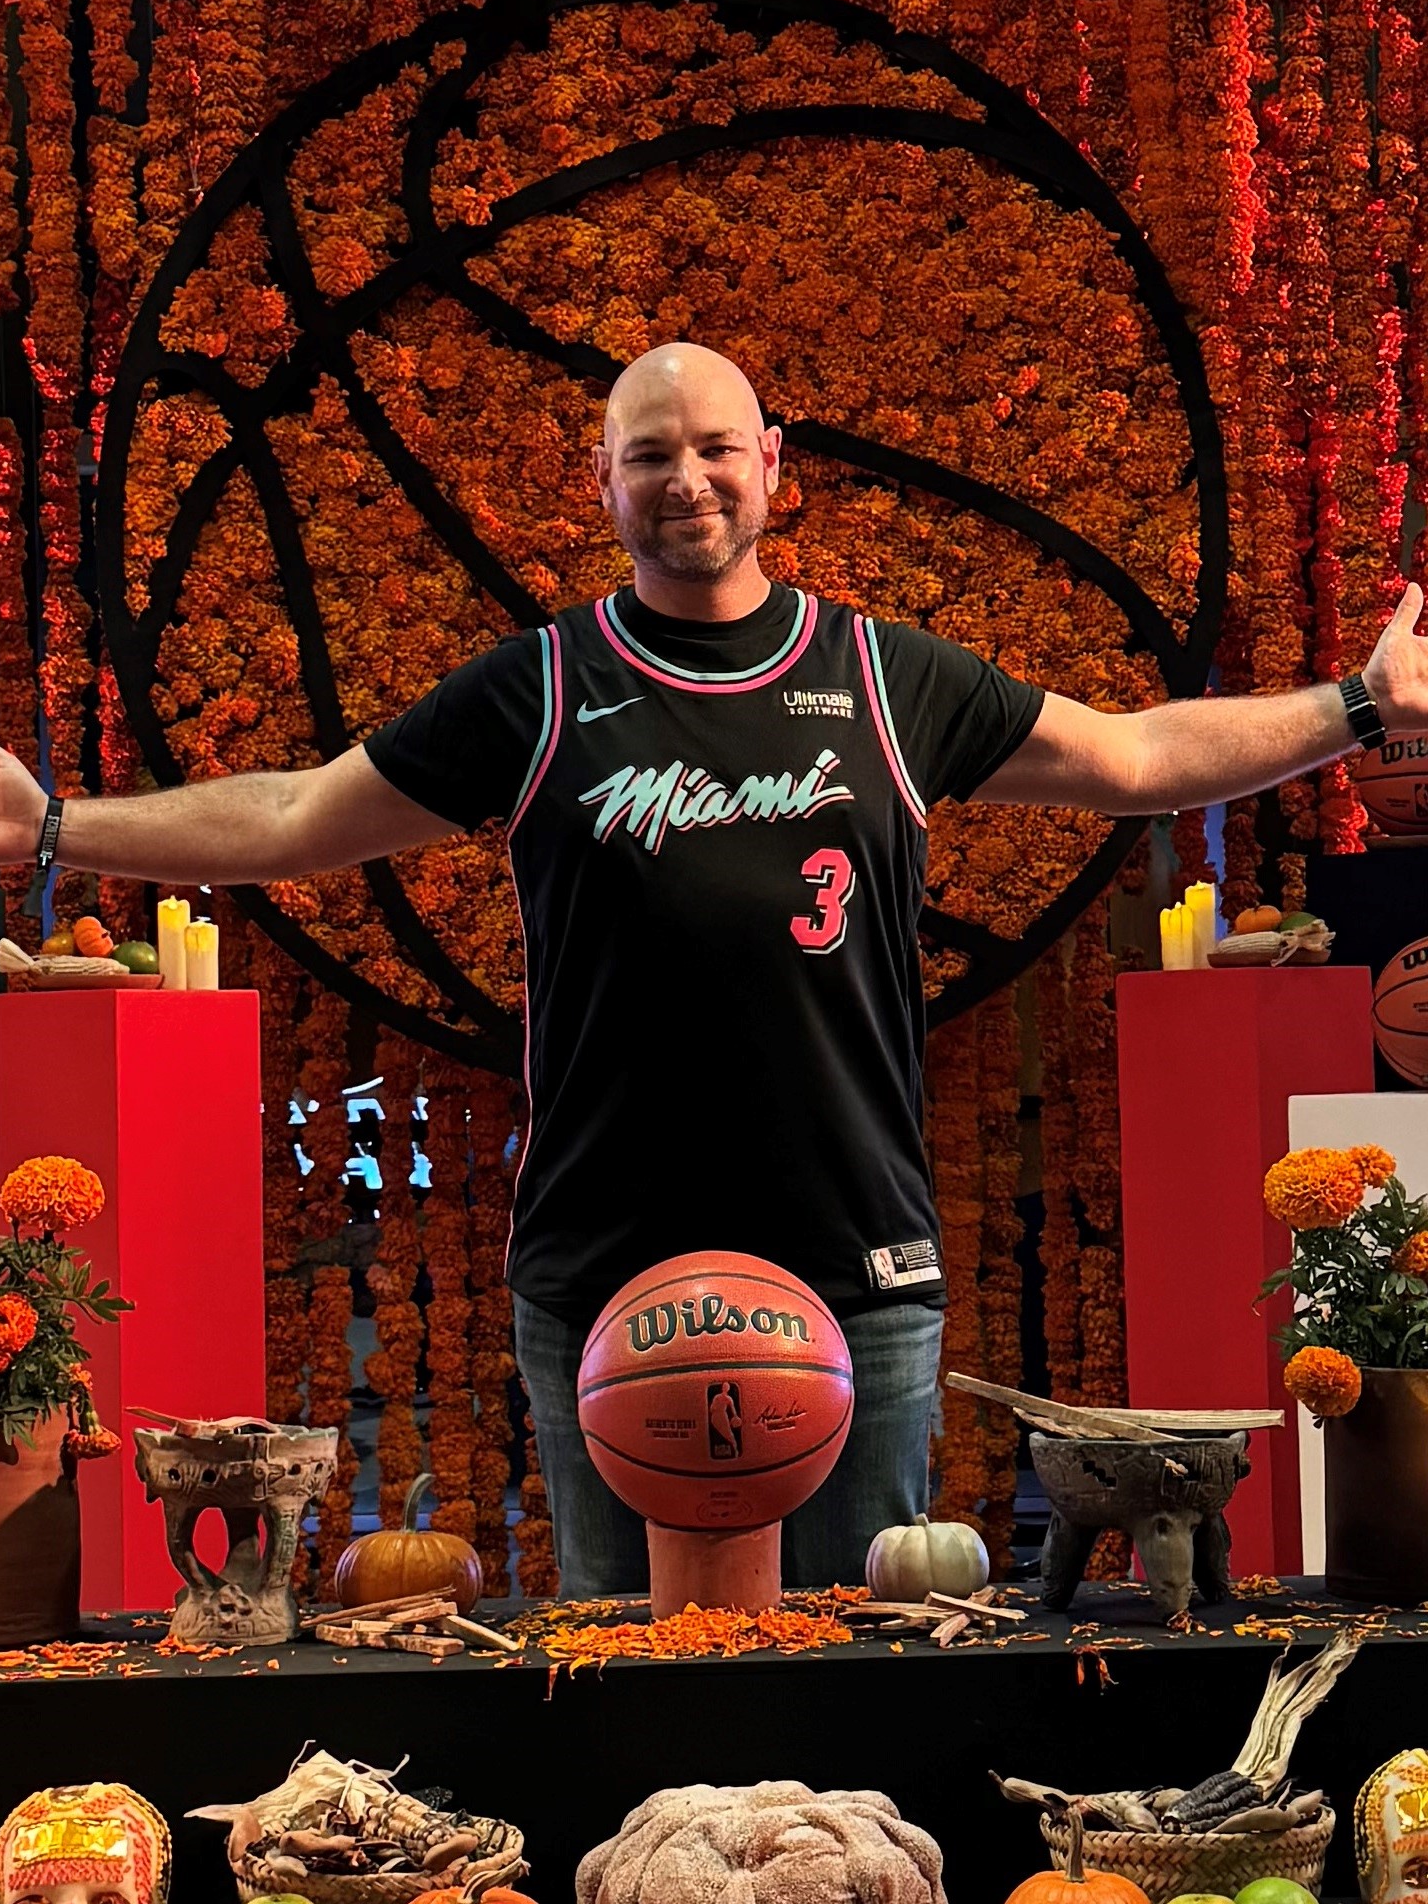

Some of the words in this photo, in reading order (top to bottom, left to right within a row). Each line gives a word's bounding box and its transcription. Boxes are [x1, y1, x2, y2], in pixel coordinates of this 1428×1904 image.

[578, 748, 856, 855] Miami
[789, 847, 857, 955] 3
[625, 1292, 810, 1353] Wilson
